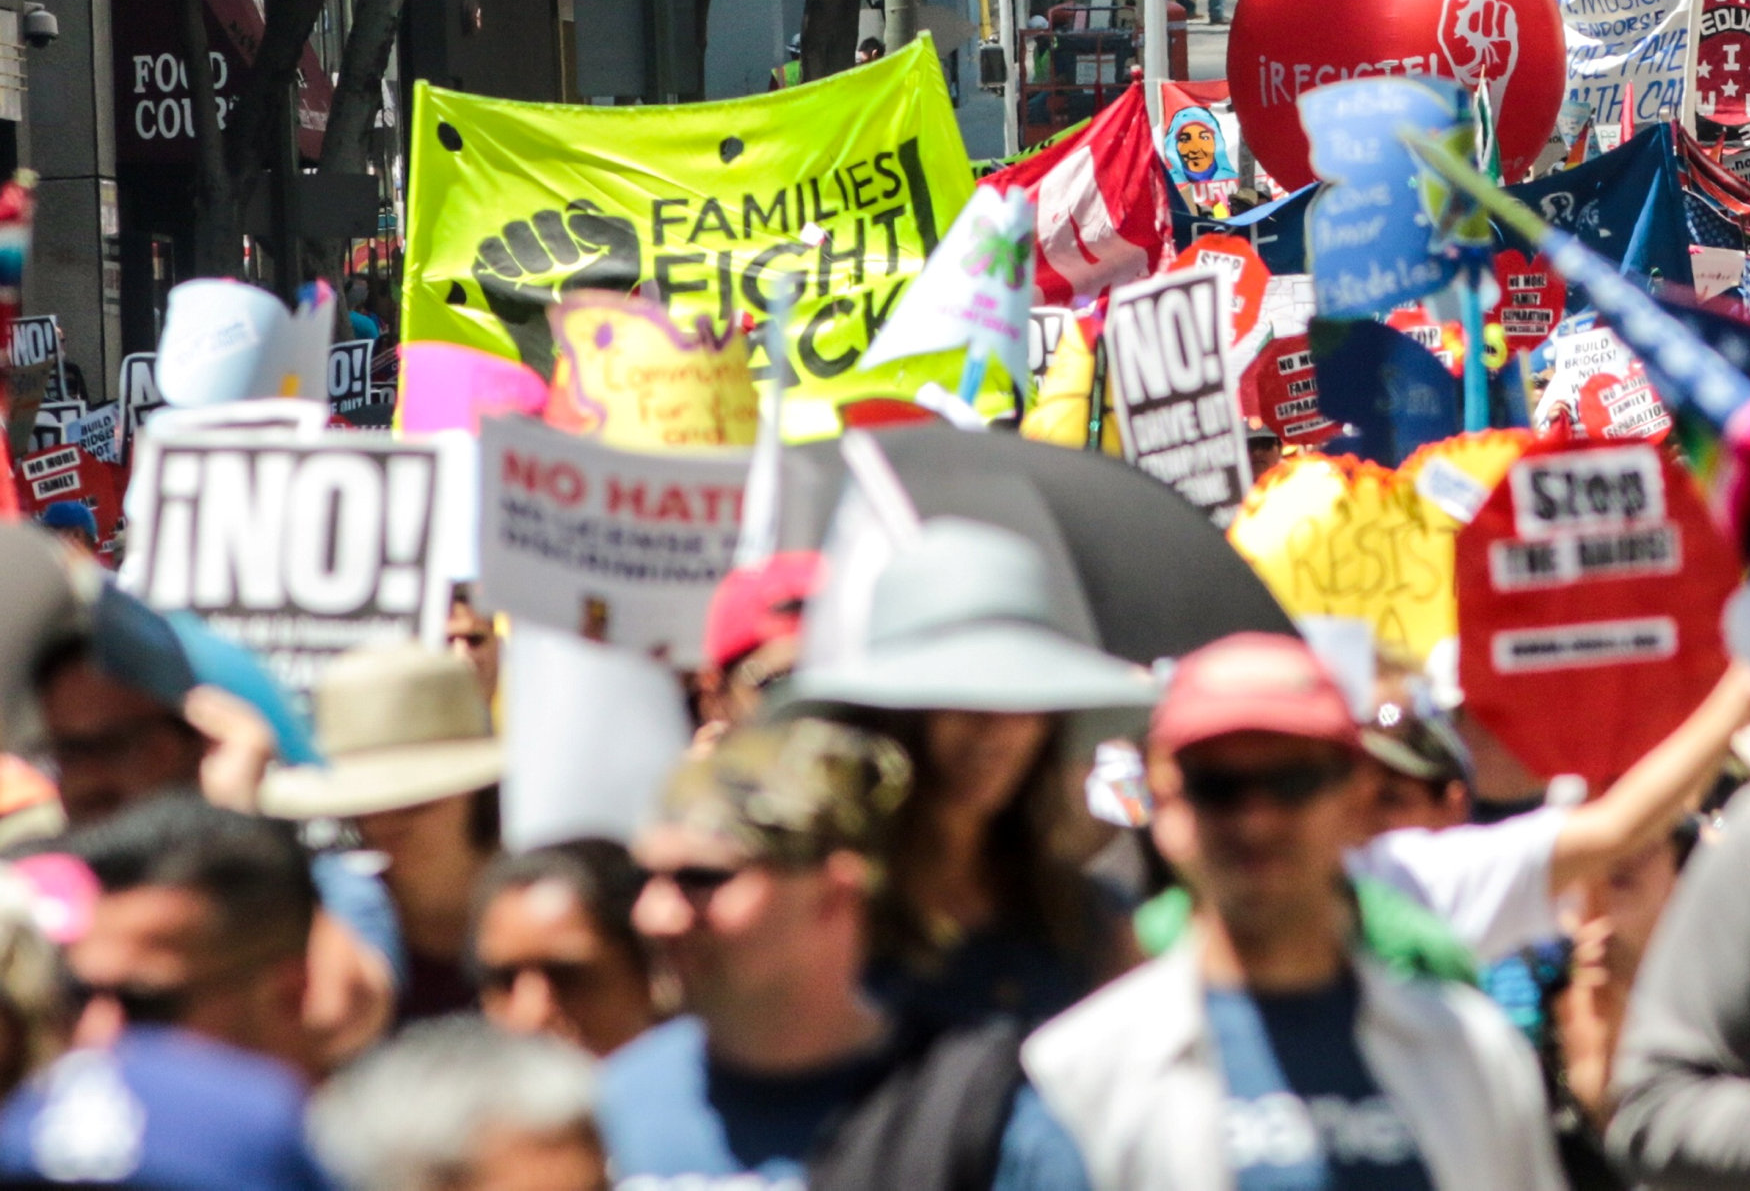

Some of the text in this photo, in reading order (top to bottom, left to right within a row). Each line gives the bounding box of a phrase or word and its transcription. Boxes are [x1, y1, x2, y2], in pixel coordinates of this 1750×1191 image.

[1577, 10, 1665, 37] ENDORSE
[1723, 44, 1741, 71] I
[133, 53, 228, 93] FOD
[652, 151, 901, 247] FAMILIES
[1191, 181, 1239, 204] UFW
[654, 205, 906, 321] FIGHT
[1508, 274, 1546, 289] NO MORE
[1512, 294, 1540, 305] FAMILY
[1502, 309, 1552, 323] SEPARATION
[746, 279, 908, 389] ACK
[1117, 282, 1223, 407] NO!
[1408, 327, 1438, 347] TOP
[1574, 338, 1609, 354] BUILD
[328, 347, 364, 397] O!
[1278, 357, 1295, 371] NO
[1564, 350, 1617, 370] BRIDGES!
[1288, 379, 1317, 397] FAMI
[1277, 399, 1318, 416] SEPARA
[1613, 393, 1648, 417] FAMILY
[80, 415, 112, 437] BUILD
[28, 450, 76, 475] NO MORE
[38, 473, 76, 494] FAMILY
[502, 449, 743, 524] NO HAT
[150, 452, 429, 615] ¡NO!
[1294, 520, 1460, 604] RESIS
